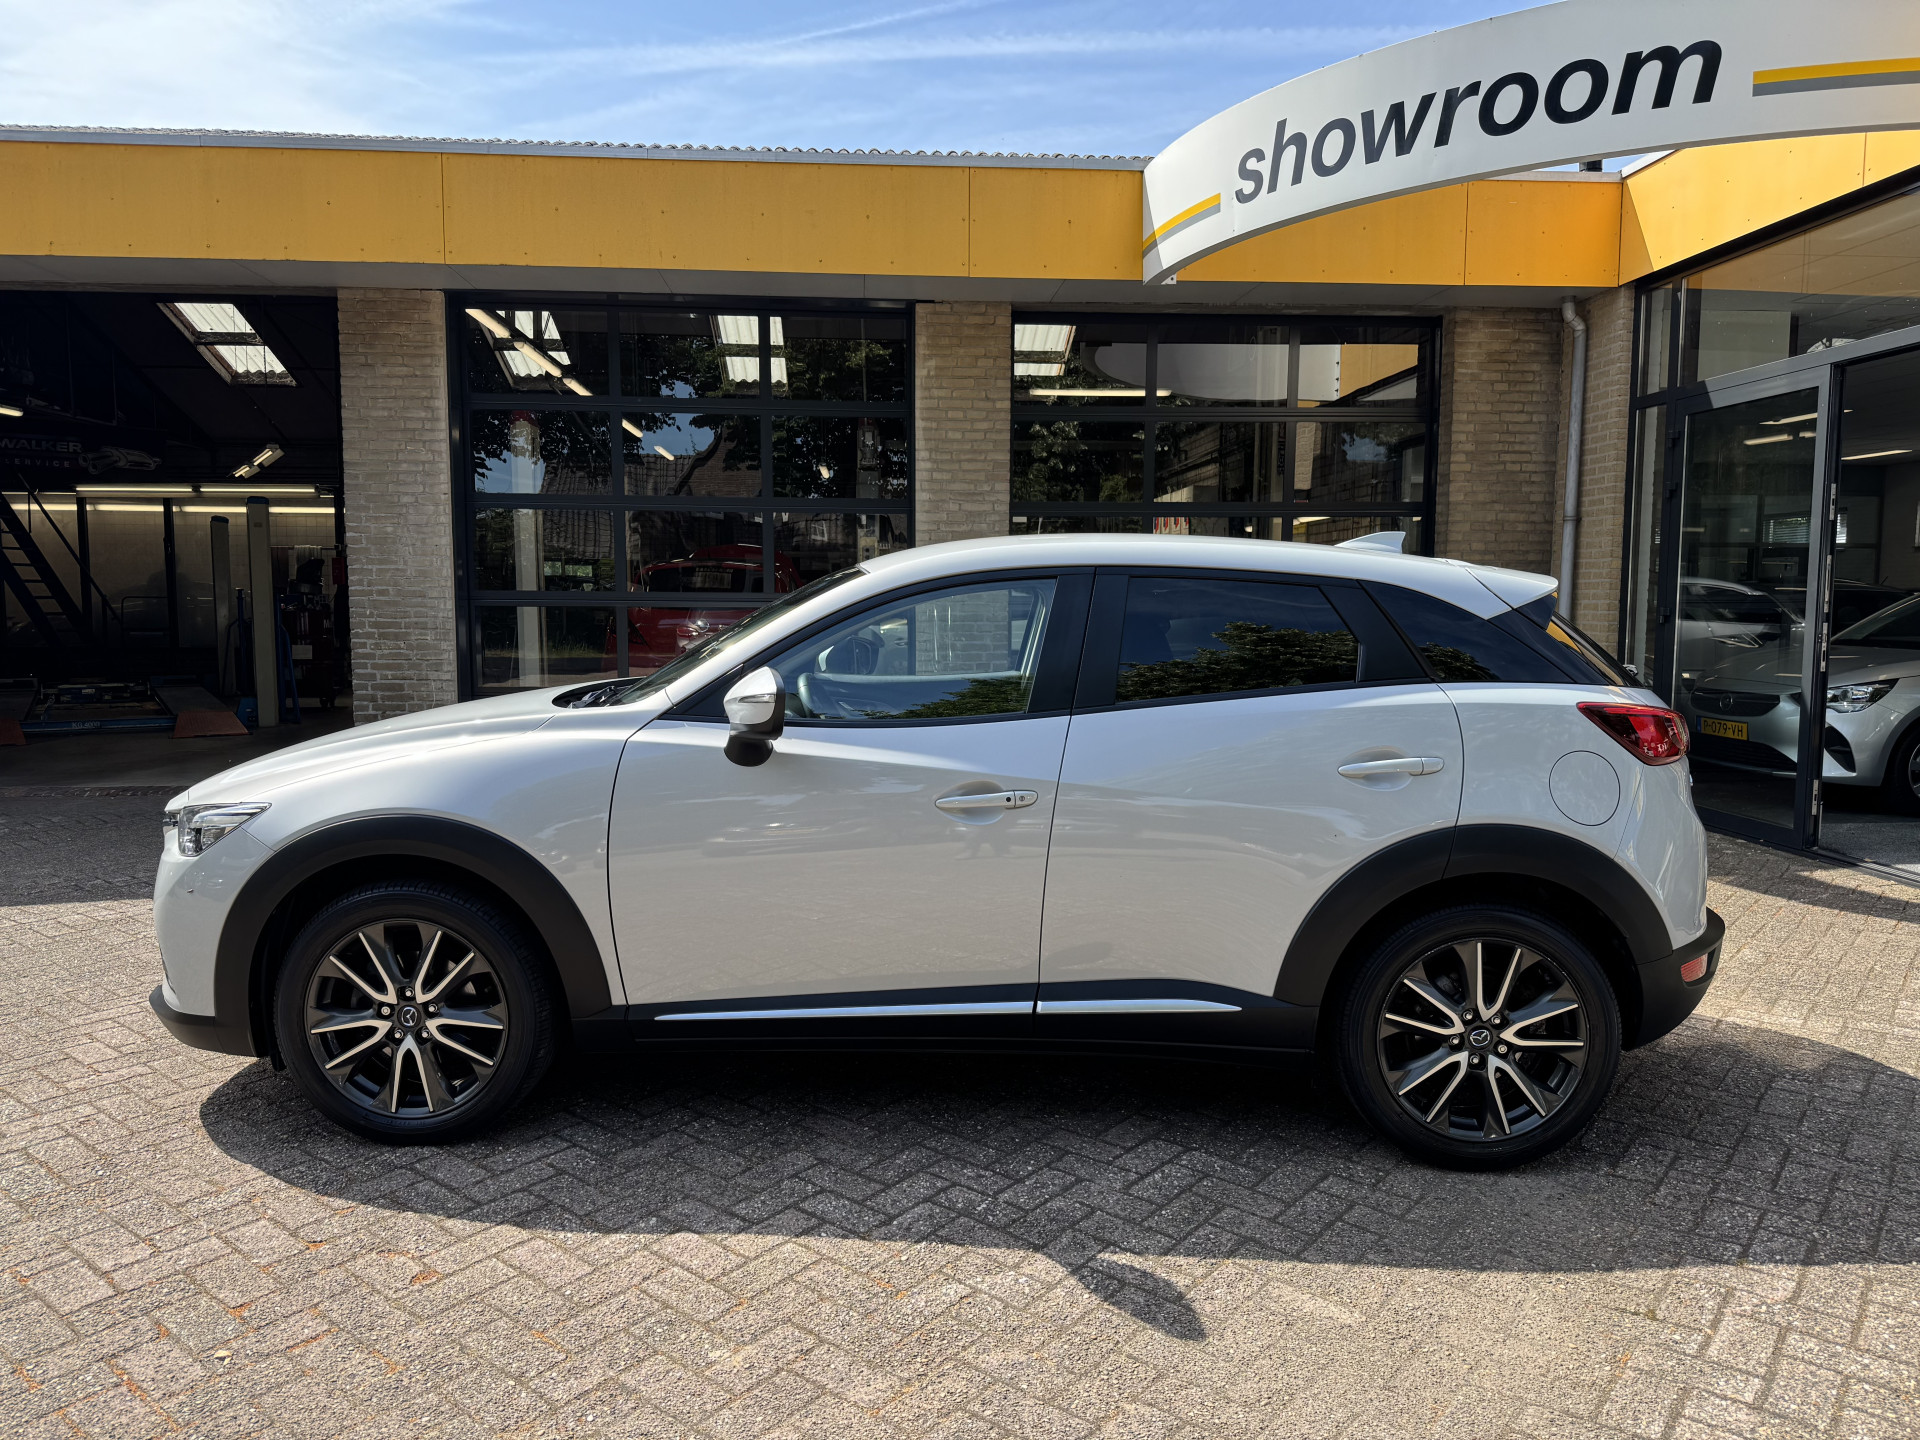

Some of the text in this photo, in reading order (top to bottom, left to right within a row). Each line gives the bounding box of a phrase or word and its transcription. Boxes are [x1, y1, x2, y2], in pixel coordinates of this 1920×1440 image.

[1234, 39, 1722, 204] showroom
[0, 438, 82, 453] WALKER
[1703, 720, 1744, 738] P-079-VH
